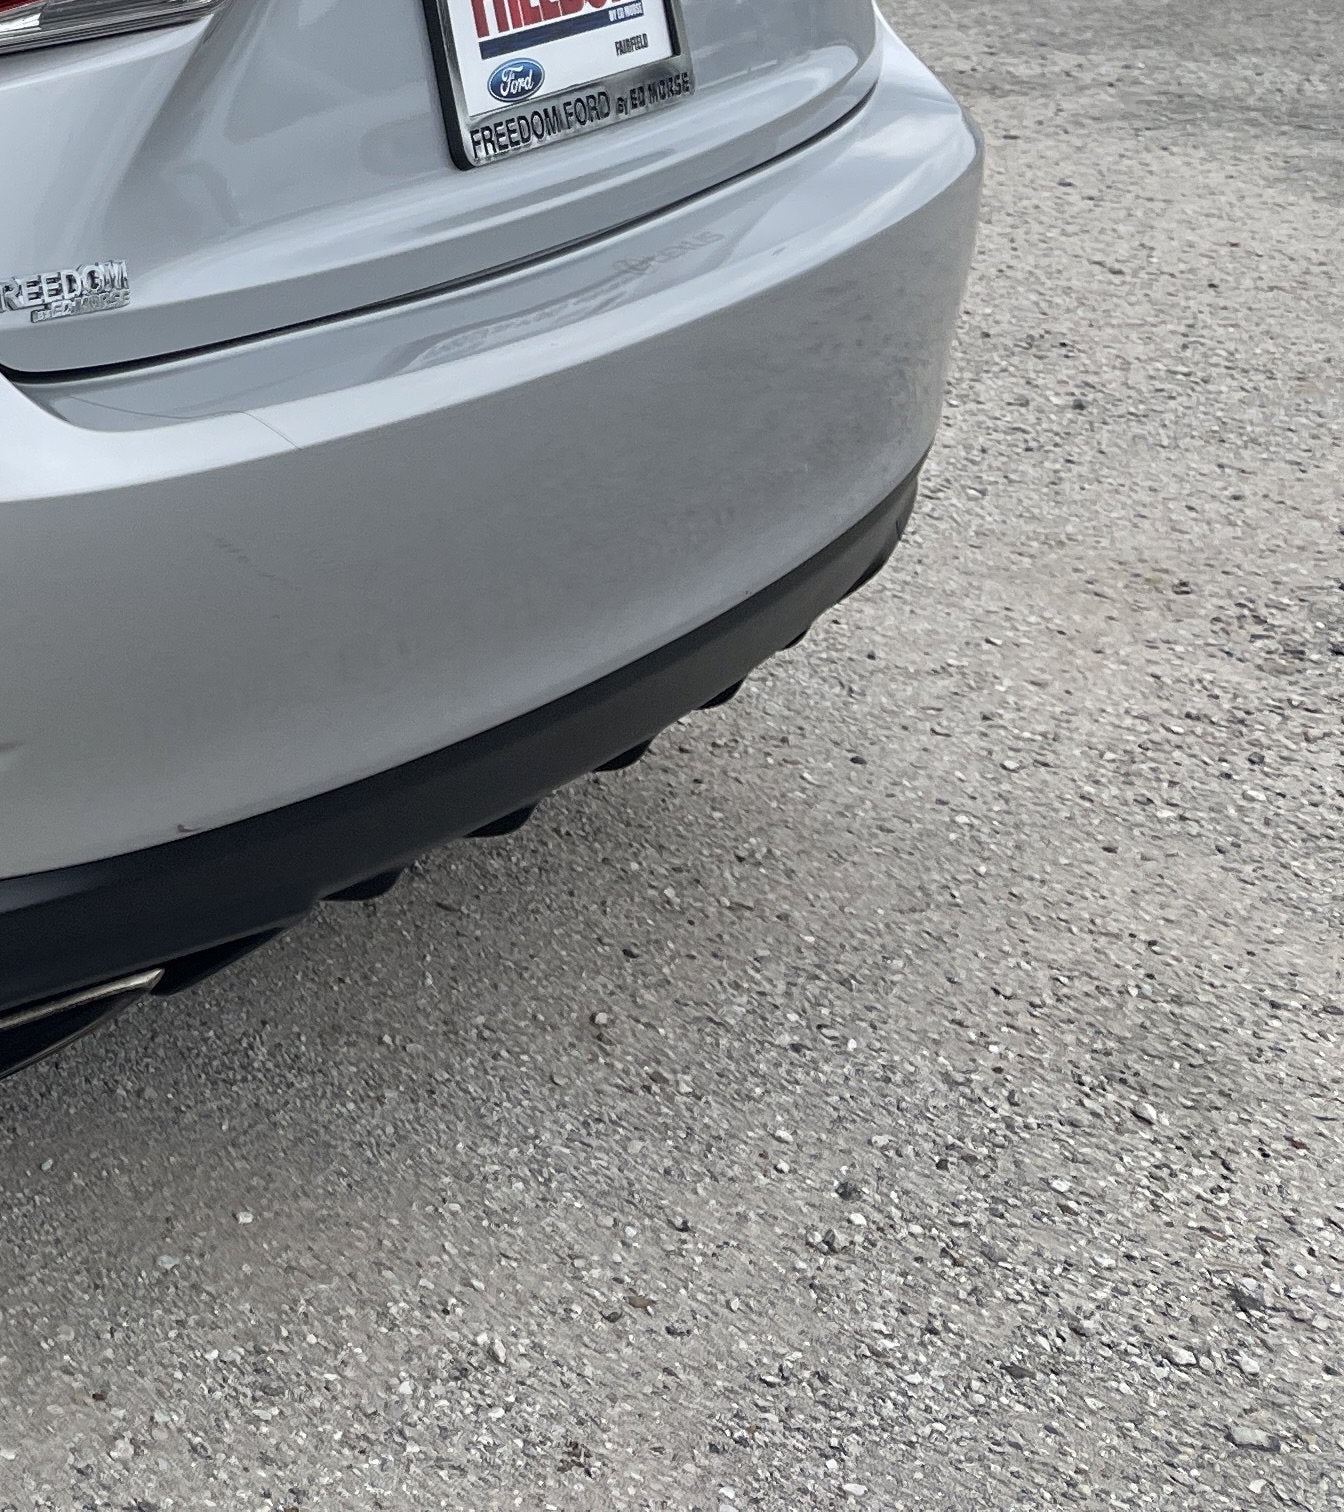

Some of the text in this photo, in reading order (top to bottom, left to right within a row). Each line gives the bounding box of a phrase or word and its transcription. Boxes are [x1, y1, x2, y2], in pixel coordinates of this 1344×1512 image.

[500, 65, 534, 96] Ford
[470, 105, 562, 159] FREEDOM
[563, 91, 611, 130] FORD
[629, 86, 646, 110] ED
[648, 72, 690, 104] MORSE
